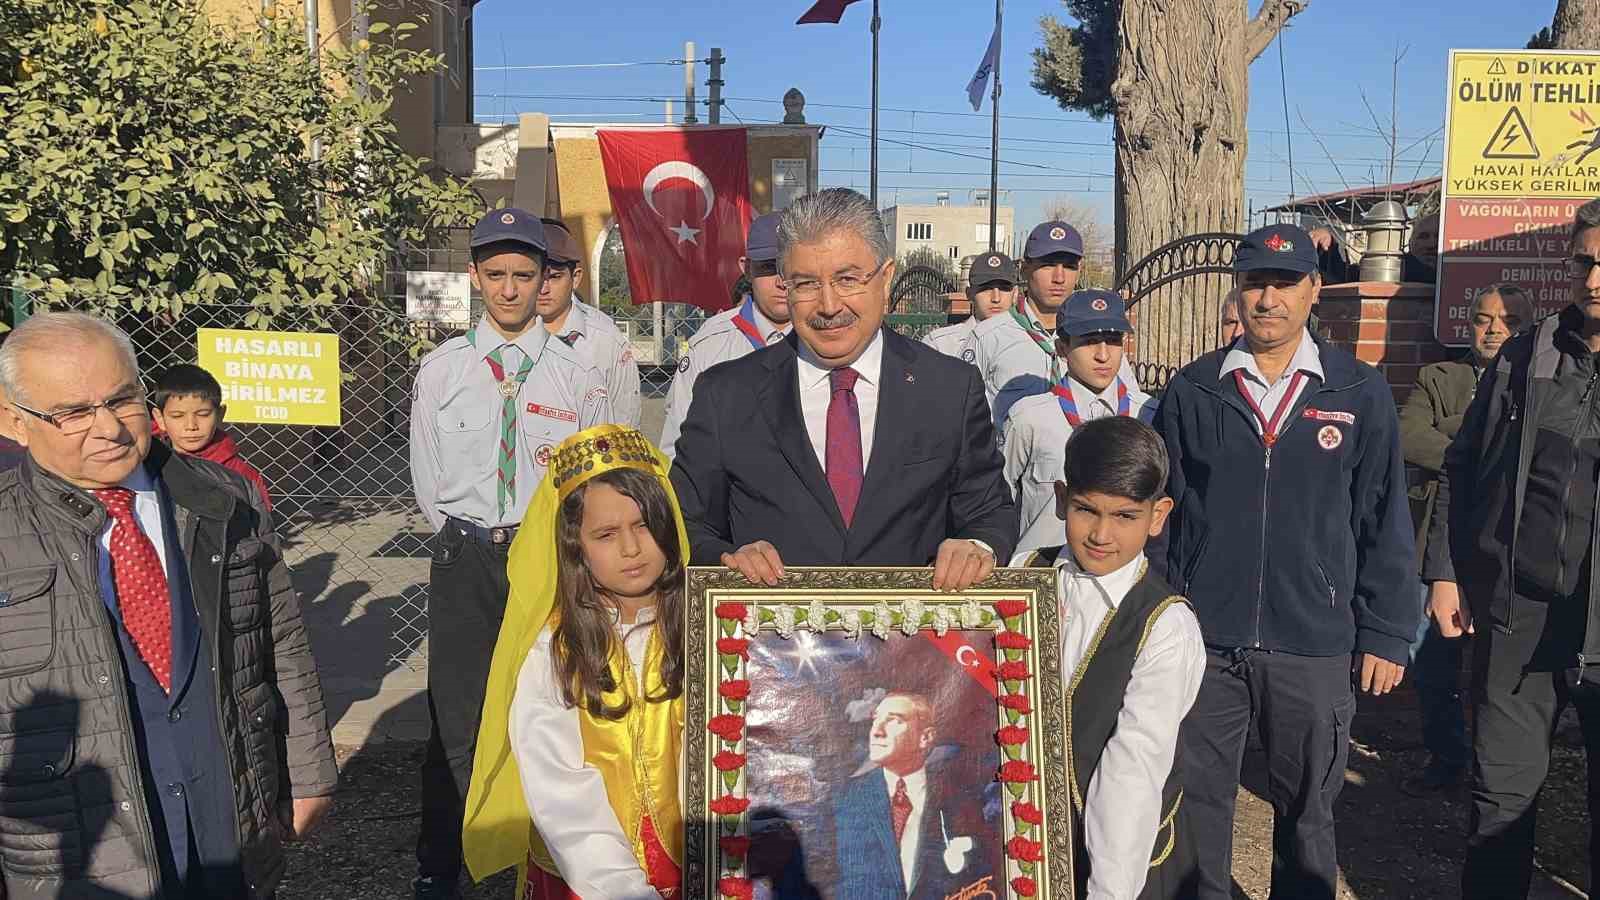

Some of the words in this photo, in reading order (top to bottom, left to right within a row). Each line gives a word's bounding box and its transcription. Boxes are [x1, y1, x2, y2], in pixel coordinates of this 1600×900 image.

[1516, 58, 1597, 76] DİKKAT
[1459, 77, 1522, 102] ÖLÜM
[1531, 165, 1598, 177] HATLAR
[1453, 178, 1523, 191] YÜKSEK
[1530, 179, 1600, 193] GERİLİM
[1460, 204, 1559, 218] VAGONLARIN
[1535, 239, 1556, 253] VE
[1501, 265, 1571, 282] DEMİRYOL
[215, 337, 321, 358] HASARLI
[224, 358, 314, 381] BİNAYA
[254, 404, 289, 420] TCDD
